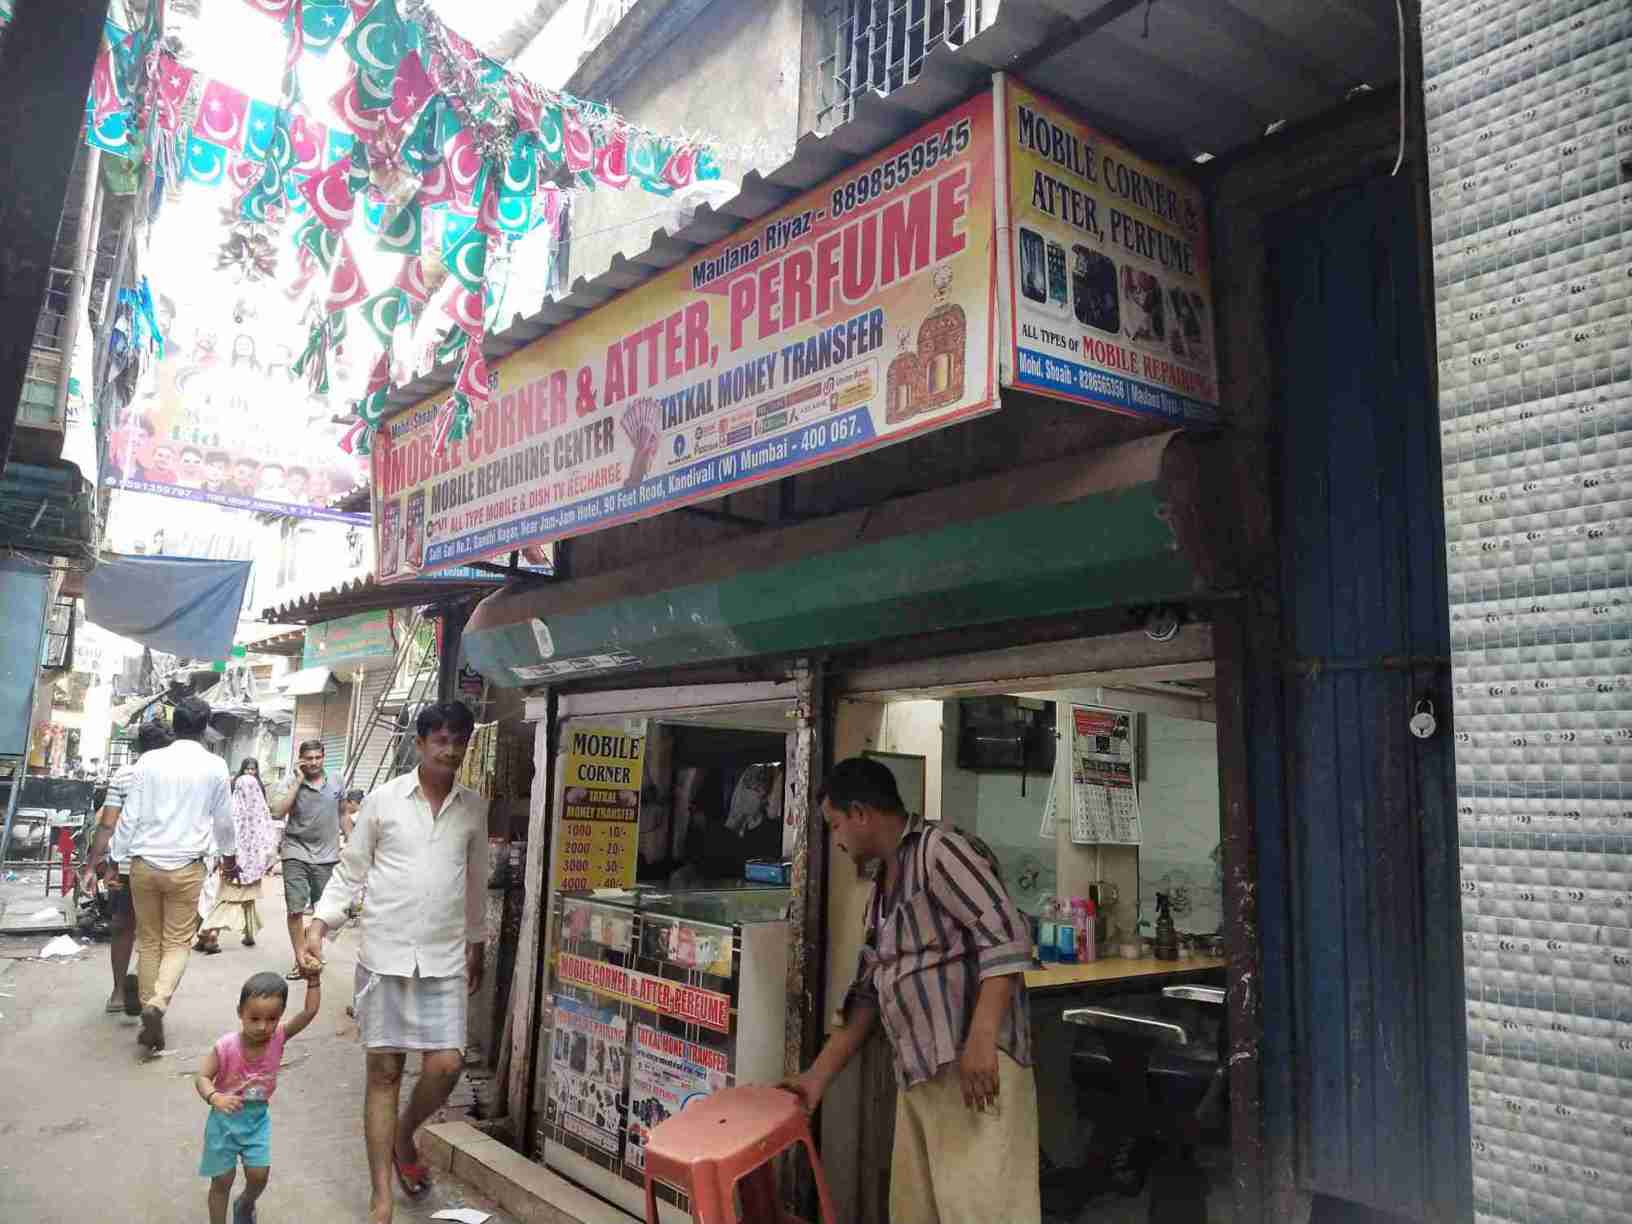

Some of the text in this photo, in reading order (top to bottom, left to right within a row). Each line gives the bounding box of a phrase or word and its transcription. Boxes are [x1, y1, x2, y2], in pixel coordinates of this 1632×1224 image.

[1017, 104, 1098, 185] MOBILE
[1102, 156, 1180, 218] CORNER
[692, 239, 760, 288] Maulana
[766, 209, 812, 252] Riyaz
[831, 120, 971, 218] 8898559545
[1031, 170, 1194, 276] ATTER, PERFUME
[466, 369, 568, 462] CORNER
[575, 366, 598, 418] &
[603, 301, 718, 406] ATTER,
[730, 168, 968, 351] PERFUME
[1022, 324, 1038, 340] ALL
[1040, 329, 1067, 349] TYPES
[1081, 335, 1138, 374] MOBILE
[660, 379, 715, 431] TATKAL
[718, 352, 778, 410] MONEY
[782, 308, 884, 385] TRANSFER
[431, 416, 615, 514] MOBILE REPAIRING CENTER
[486, 494, 517, 521] MOBILE
[567, 462, 624, 497] RECHARGE
[617, 488, 637, 510] Feet
[639, 481, 667, 505] Road,
[669, 461, 715, 495] Kandivali
[718, 455, 737, 483] (W)
[741, 438, 789, 471] Mumbai
[801, 428, 827, 452] 400
[572, 733, 640, 760] MOBILE
[578, 763, 631, 784] CORNER
[567, 824, 592, 837] 1000
[561, 878, 587, 889] 4000
[562, 859, 589, 872] 3000
[560, 956, 592, 983] MOBILE
[674, 985, 729, 1025] PERFUME
